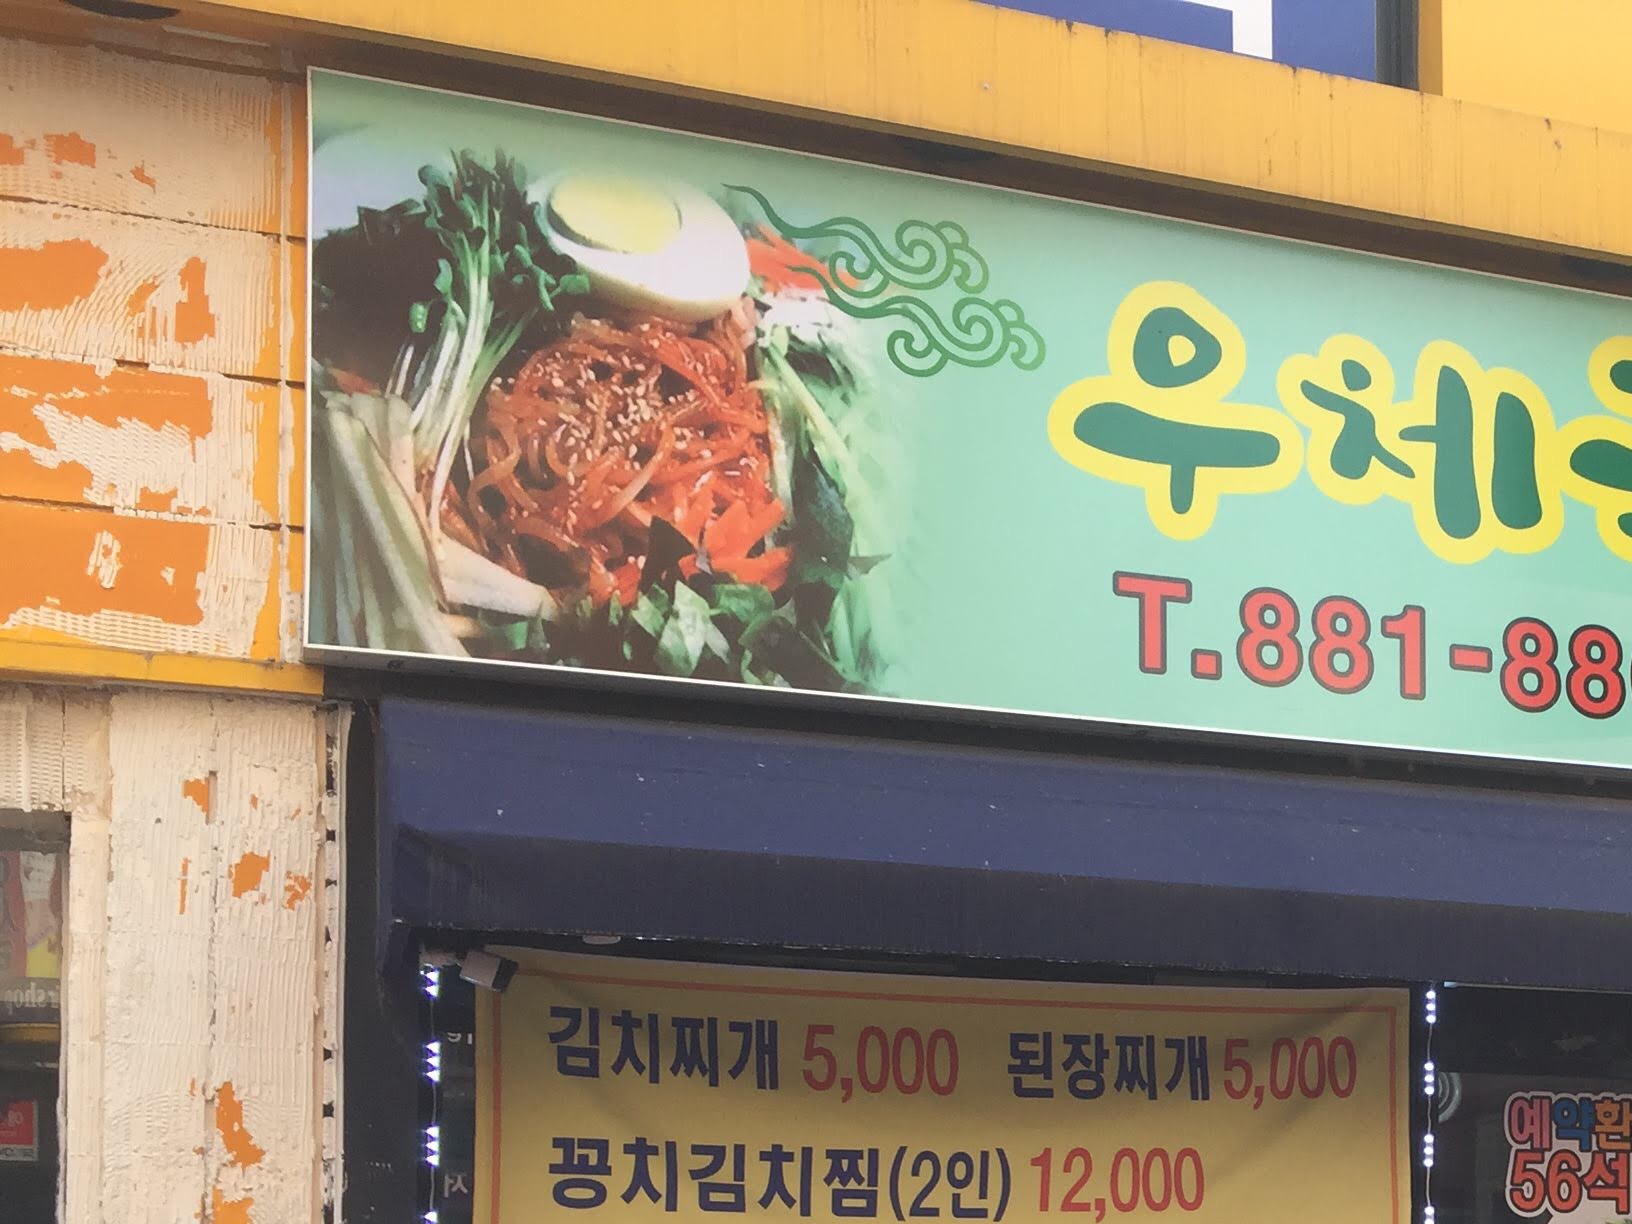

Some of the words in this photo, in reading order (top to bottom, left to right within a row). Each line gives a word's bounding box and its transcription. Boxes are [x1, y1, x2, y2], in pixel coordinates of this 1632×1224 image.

[548, 1005, 779, 1090] 김치찌개
[802, 1025, 960, 1103] 5,000
[1007, 1030, 1211, 1101] 된장찌개
[1223, 1036, 1358, 1110] 5,000
[1029, 1146, 1206, 1223] 12,000
[1510, 1151, 1630, 1215] 56석
